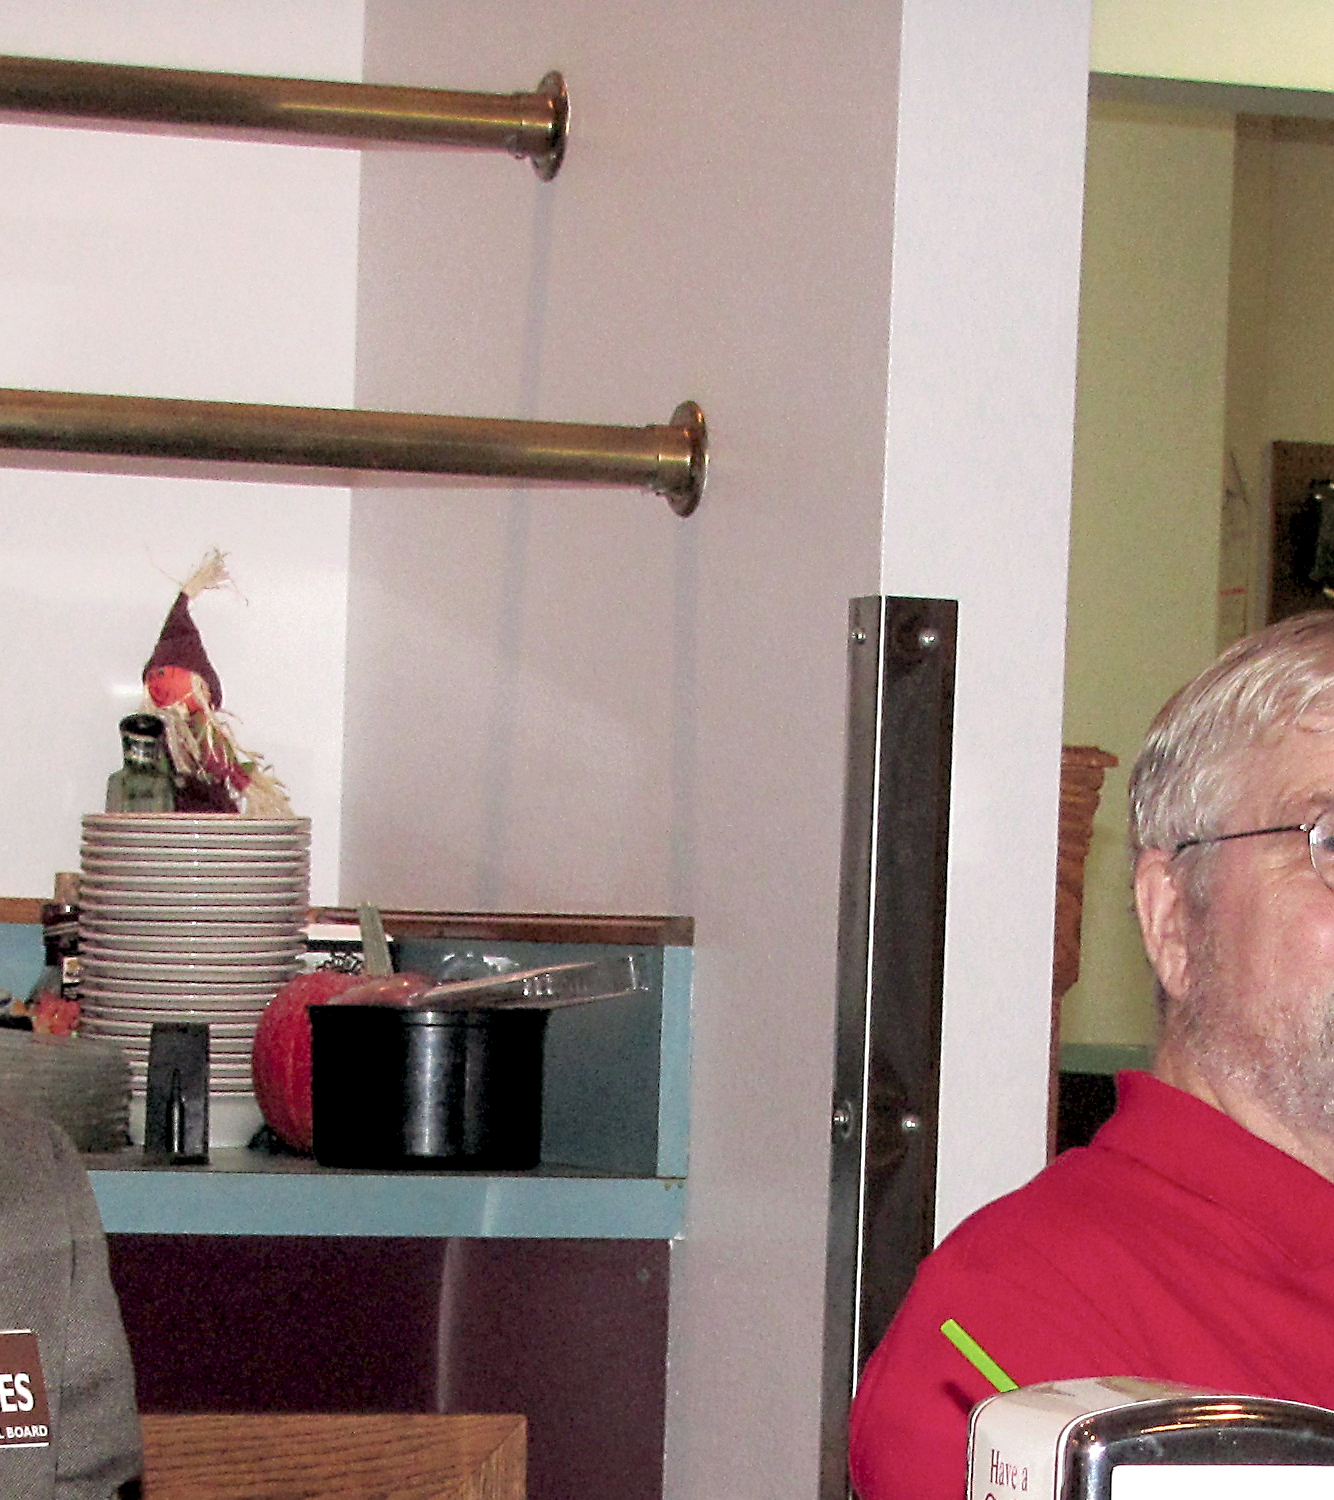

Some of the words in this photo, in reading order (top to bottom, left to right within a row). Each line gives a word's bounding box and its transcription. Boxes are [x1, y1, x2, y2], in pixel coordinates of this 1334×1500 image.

[6, 1424, 48, 1439] BOARD
[989, 1448, 1018, 1490] Have
[1021, 1466, 1028, 1491] a
